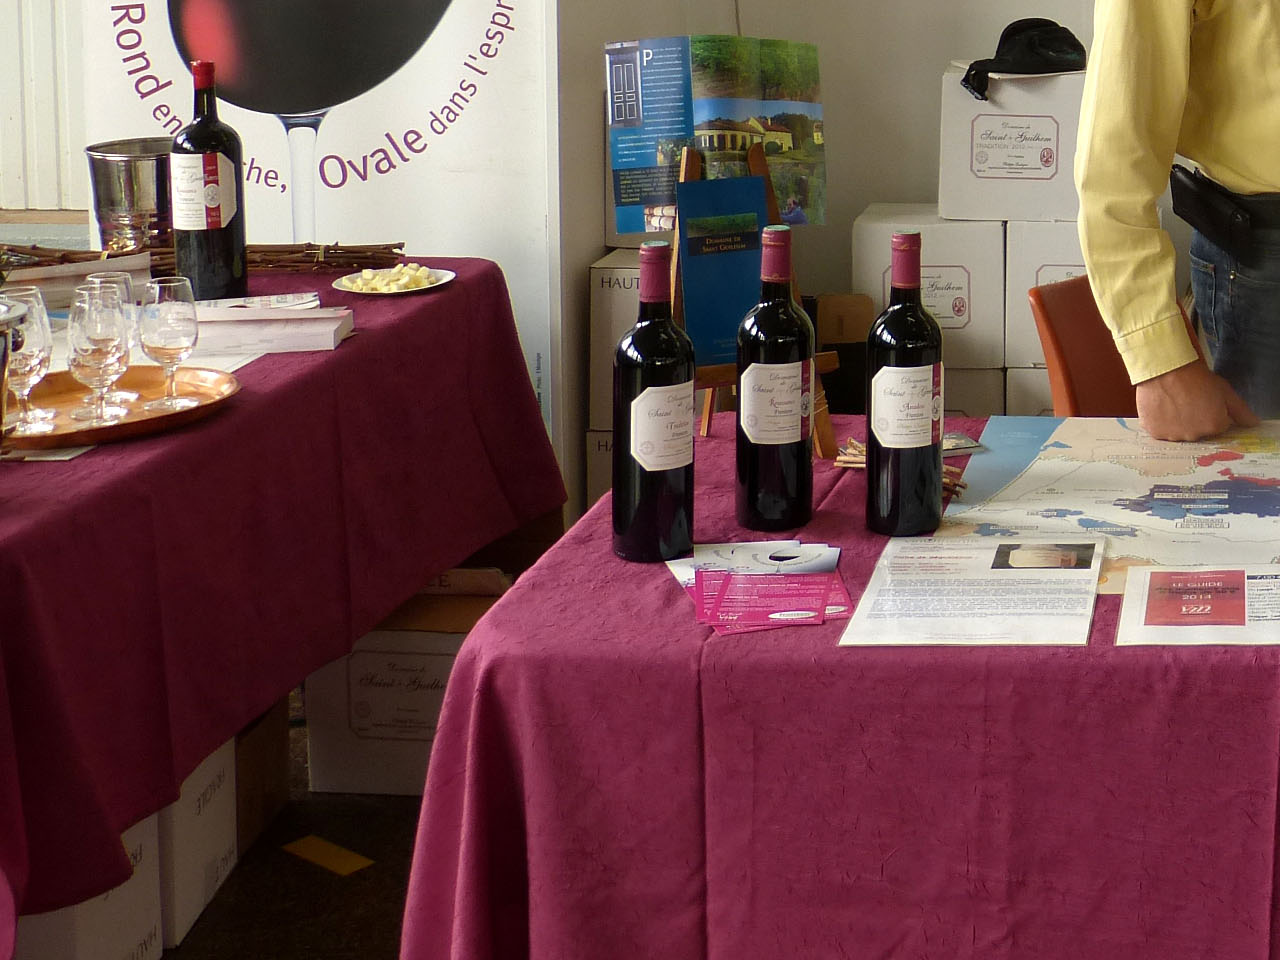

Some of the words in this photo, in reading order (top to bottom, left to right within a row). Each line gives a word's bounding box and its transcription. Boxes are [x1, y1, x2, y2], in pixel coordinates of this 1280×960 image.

[110, 2, 172, 100] Rond
[318, 128, 428, 190] Ovale
[429, 80, 478, 136] dans
